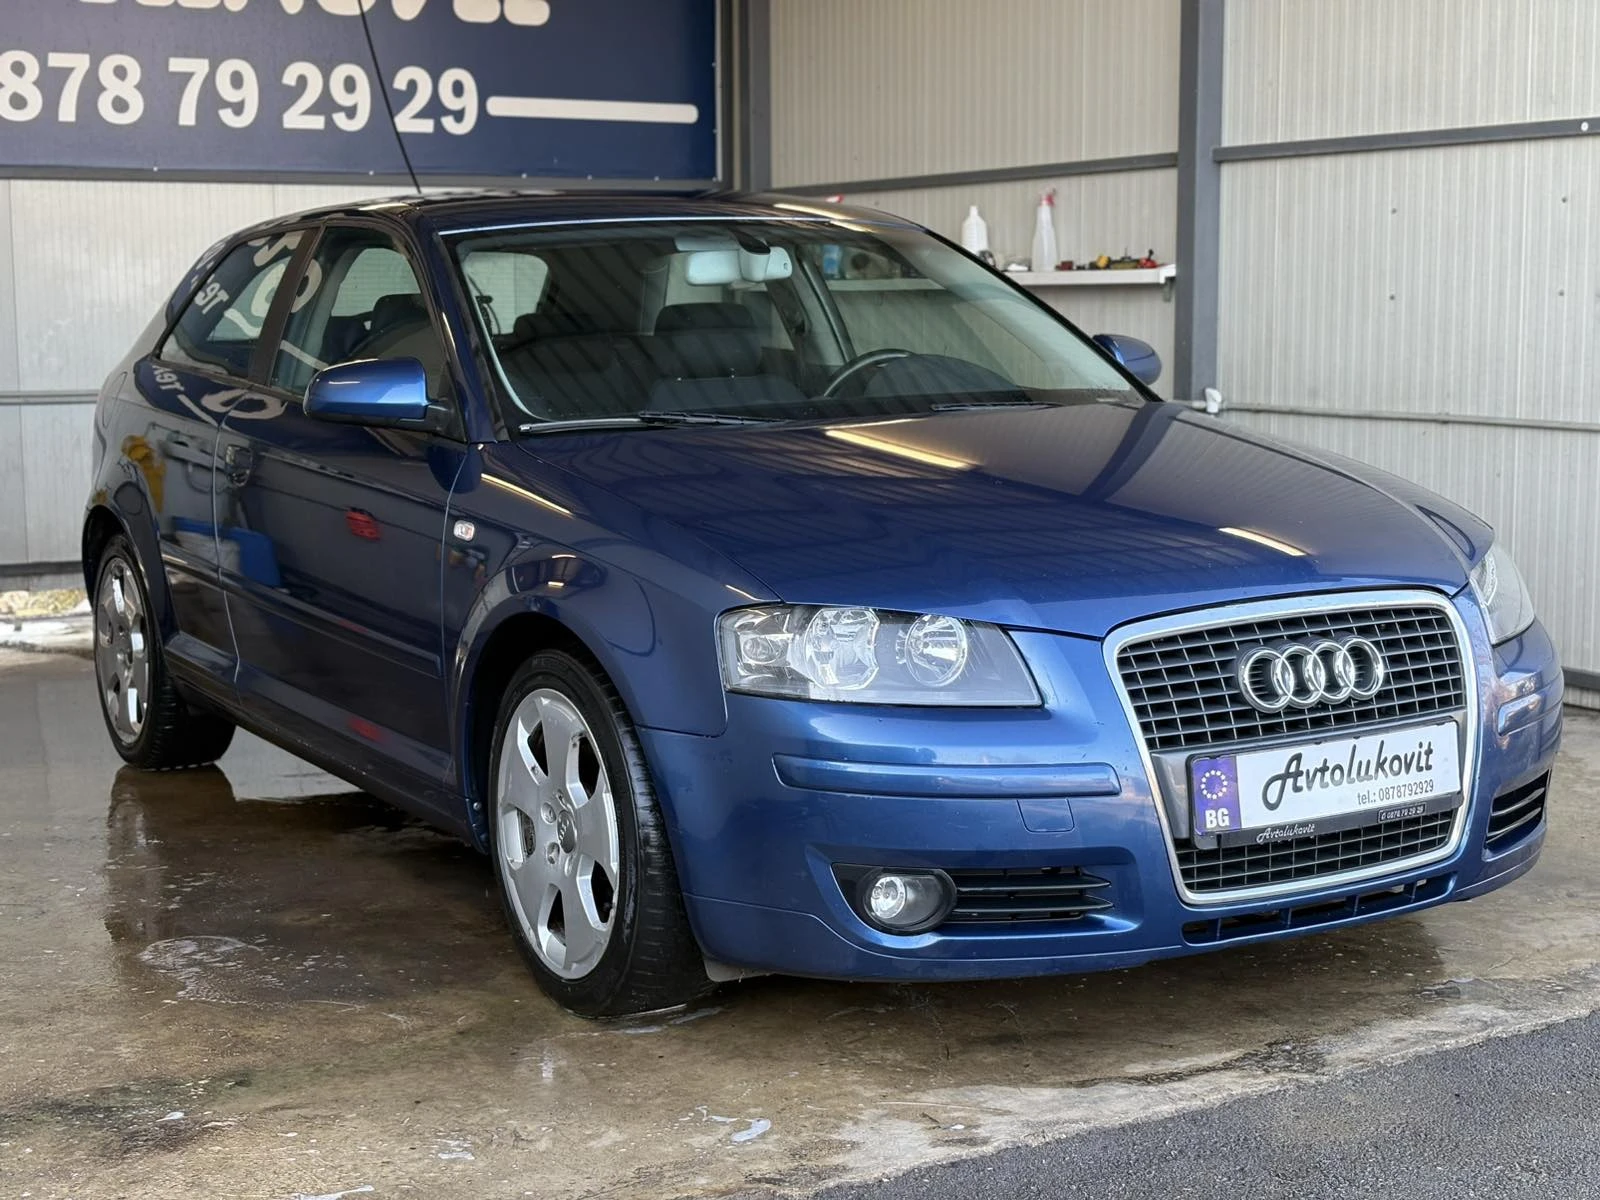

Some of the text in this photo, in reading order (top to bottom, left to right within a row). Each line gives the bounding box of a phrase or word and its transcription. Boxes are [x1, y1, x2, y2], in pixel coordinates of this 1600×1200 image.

[0, 50, 479, 135] 878 79 29 29
[1262, 740, 1434, 811] Avtolukovit
[1357, 778, 1434, 805] tel.: 0878792929
[1204, 807, 1230, 829] BG
